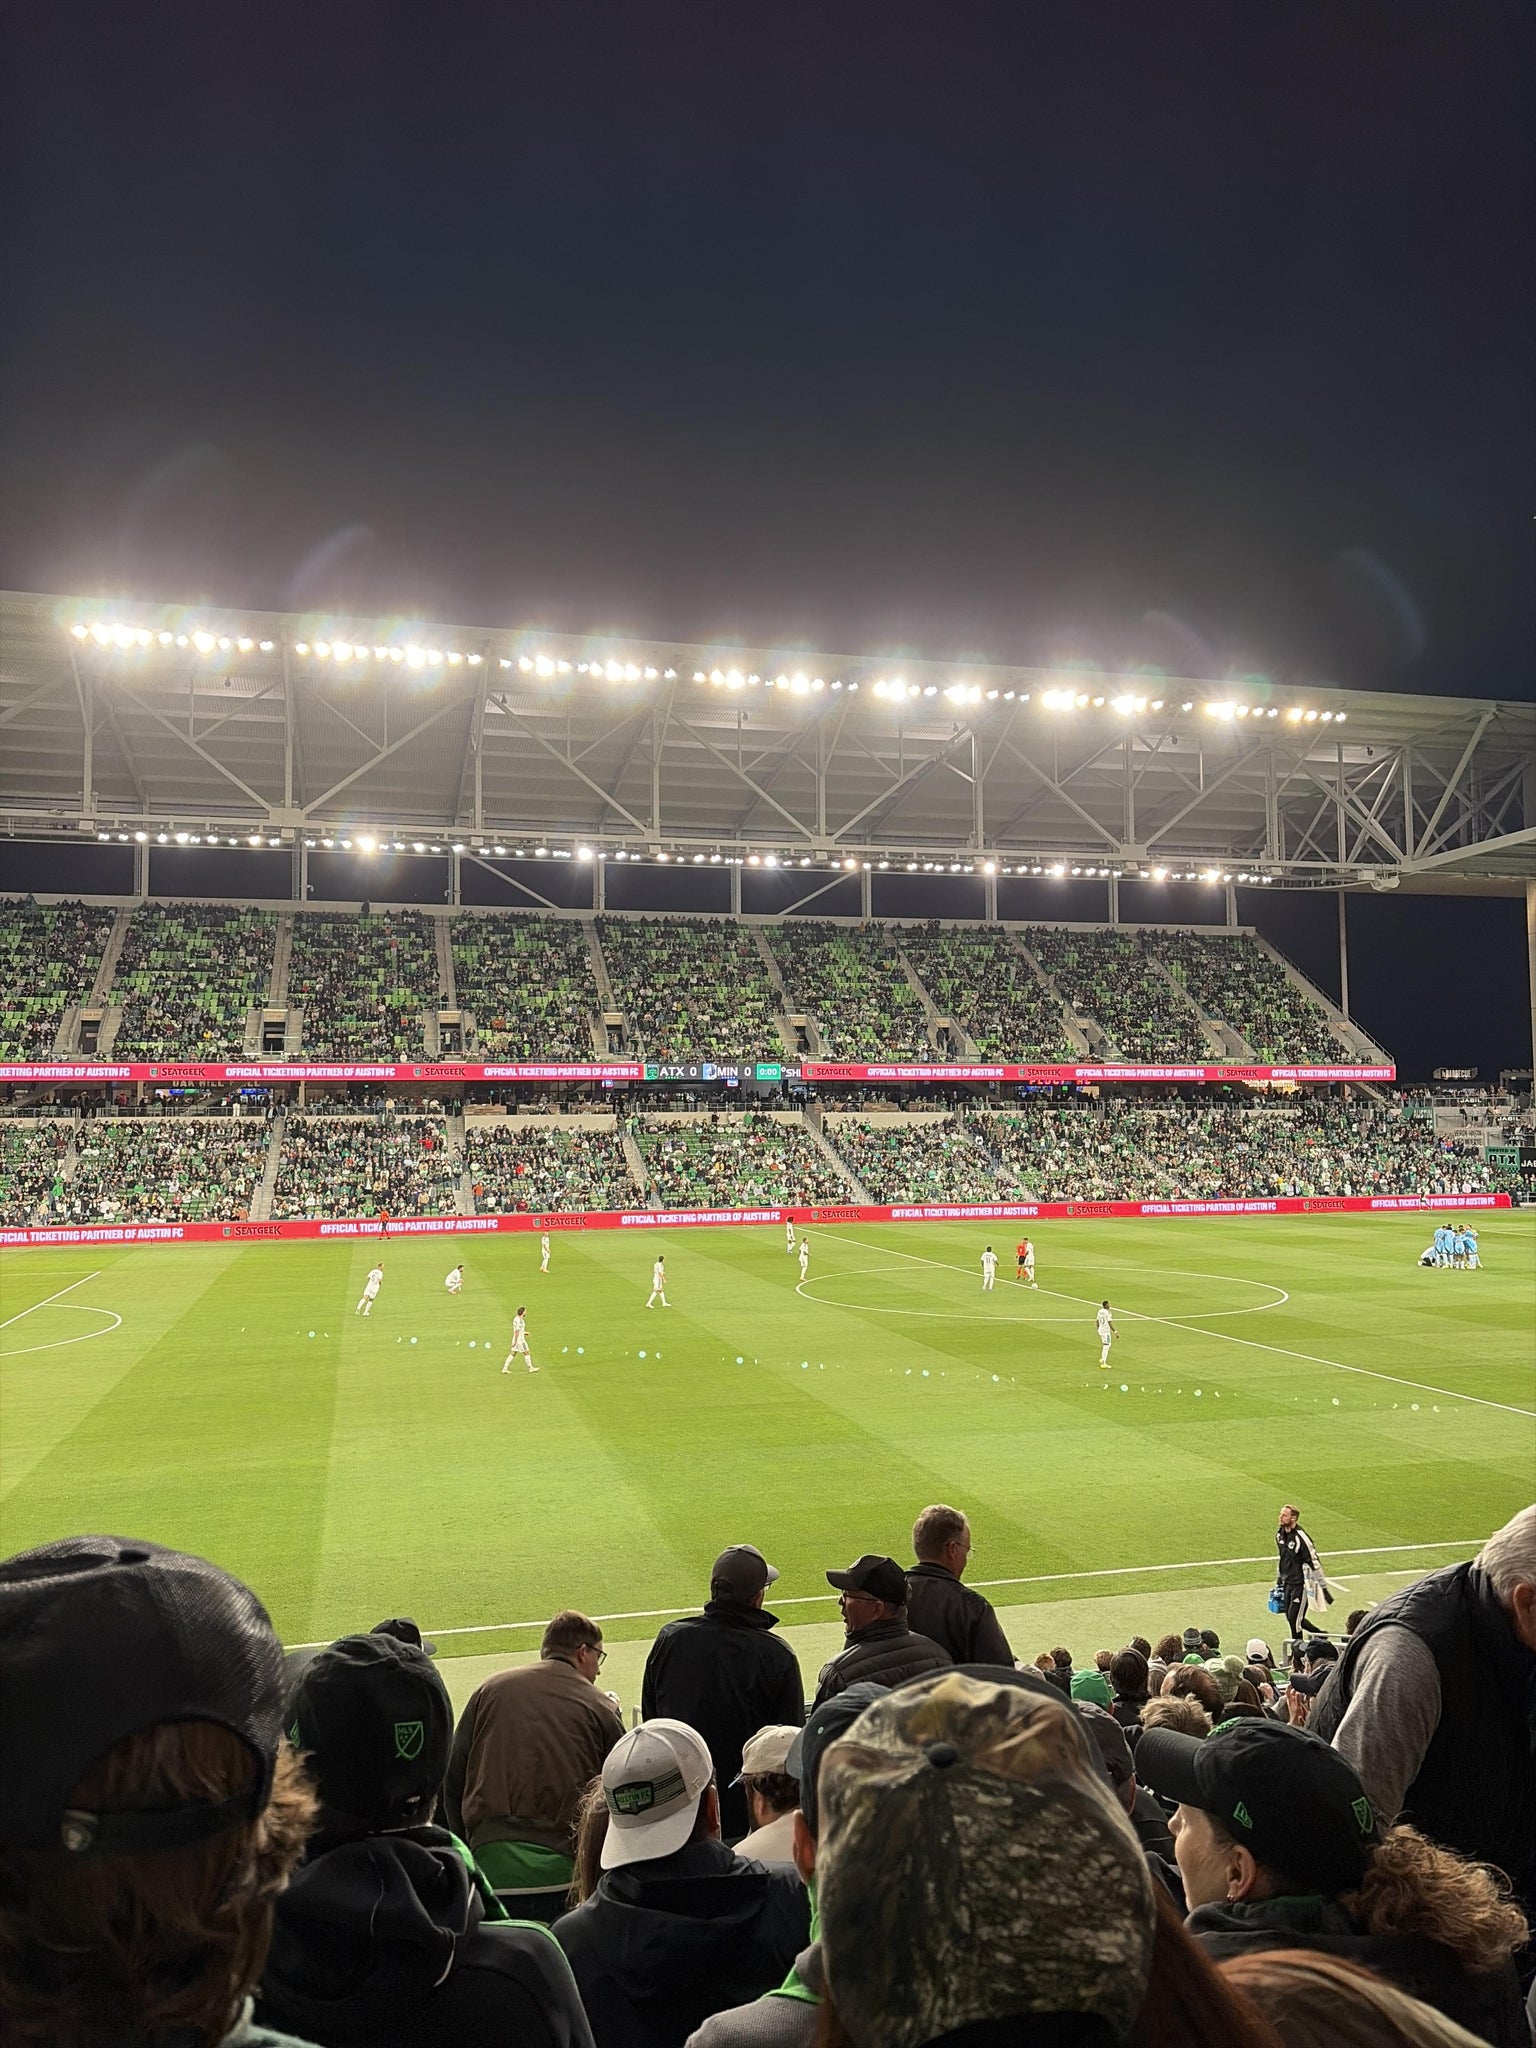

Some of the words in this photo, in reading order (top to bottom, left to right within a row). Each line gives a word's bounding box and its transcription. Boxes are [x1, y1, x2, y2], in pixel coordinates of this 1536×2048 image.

[34, 1067, 73, 1077] PARTNER
[75, 1067, 86, 1077] OF
[87, 1067, 118, 1077] AUSTIN
[120, 1067, 130, 1077] FC
[162, 1067, 205, 1076] SEATGEEK
[226, 1067, 261, 1076] OFFICIAL
[263, 1067, 304, 1076] TICKETING
[305, 1067, 343, 1076] PARTNER
[344, 1067, 354, 1076] OF
[355, 1067, 385, 1076] AUSTIN
[386, 1067, 396, 1076] FC
[425, 1067, 465, 1076] SEATGEEK
[484, 1067, 517, 1076] OFFICIAL
[518, 1067, 557, 1076] TICKETING
[558, 1067, 591, 1076] PARTNER
[592, 1067, 600, 1076] OF
[601, 1067, 628, 1076] AUSTIN
[629, 1067, 639, 1076] FC
[660, 1066, 685, 1077] ATX
[689, 1067, 697, 1077] 0
[717, 1066, 738, 1077] MIN
[744, 1067, 751, 1077] 0
[759, 1068, 777, 1076] 0:00
[816, 1067, 852, 1076] SEATGEEK
[867, 1068, 896, 1077] OFFICIAL
[897, 1068, 930, 1077] TICKETING
[931, 1068, 960, 1077] PARTNER
[962, 1068, 971, 1077] OF
[971, 1068, 994, 1077] AUSTIN
[995, 1068, 1004, 1077] FC
[1027, 1068, 1061, 1076] SEATGEEK
[1075, 1068, 1102, 1077] OFFICIAL
[1103, 1068, 1136, 1077] TICKETING
[1136, 1068, 1164, 1077] PARTNER
[1165, 1068, 1173, 1077] OF
[1173, 1068, 1195, 1077] AUSTIN
[1196, 1068, 1204, 1077] FC
[1271, 1069, 1296, 1077] OFFICIAL
[1297, 1069, 1328, 1077] TICKETING
[1329, 1069, 1354, 1077] PARTNER
[1354, 1069, 1361, 1077] OF
[1362, 1069, 1382, 1077] AUSTIN
[1383, 1069, 1391, 1077] FC
[1312, 1201, 1345, 1209] SEATGEEK
[1372, 1199, 1398, 1208] OFFICIAL
[1431, 1197, 1457, 1206] PARTNER
[1458, 1197, 1465, 1205] OF
[1466, 1197, 1487, 1205] AUSTIN
[1488, 1196, 1495, 1205] FC
[892, 1208, 923, 1218] OFFICIAL
[924, 1208, 961, 1217] TICKETING
[961, 1207, 993, 1216] PARTNER
[994, 1207, 1003, 1215] OF
[1003, 1207, 1028, 1215] AUSTIN
[1030, 1206, 1038, 1215] FC
[1077, 1205, 1112, 1214] SEATGEEK
[1142, 1205, 1170, 1213] OFFICIAL
[1171, 1204, 1205, 1212] TICKETING
[1206, 1203, 1235, 1212] PARTNER
[1236, 1203, 1244, 1211] OF
[1245, 1202, 1268, 1211] AUSTIN
[1268, 1202, 1276, 1210] FC
[622, 1215, 656, 1225] OFFICIAL
[656, 1214, 697, 1224] TICKETING
[698, 1213, 732, 1223] PARTNER
[733, 1212, 742, 1222] OF
[742, 1212, 769, 1221] AUSTIN
[771, 1211, 780, 1220] FC
[822, 1209, 861, 1219] SEATGEEK
[544, 1216, 587, 1226] SEATGEEK
[235, 1225, 282, 1235] SEATGEEK
[320, 1223, 358, 1234] OFFICIAL
[405, 1221, 444, 1232] PARTNER
[445, 1220, 455, 1230] OF
[456, 1219, 487, 1230] AUSTIN
[489, 1219, 498, 1228] FC
[30, 1231, 80, 1242] TICKETING
[81, 1229, 124, 1241] PARTNER
[125, 1229, 137, 1240] OF
[139, 1228, 170, 1239] AUSTIN
[172, 1227, 184, 1238] FC
